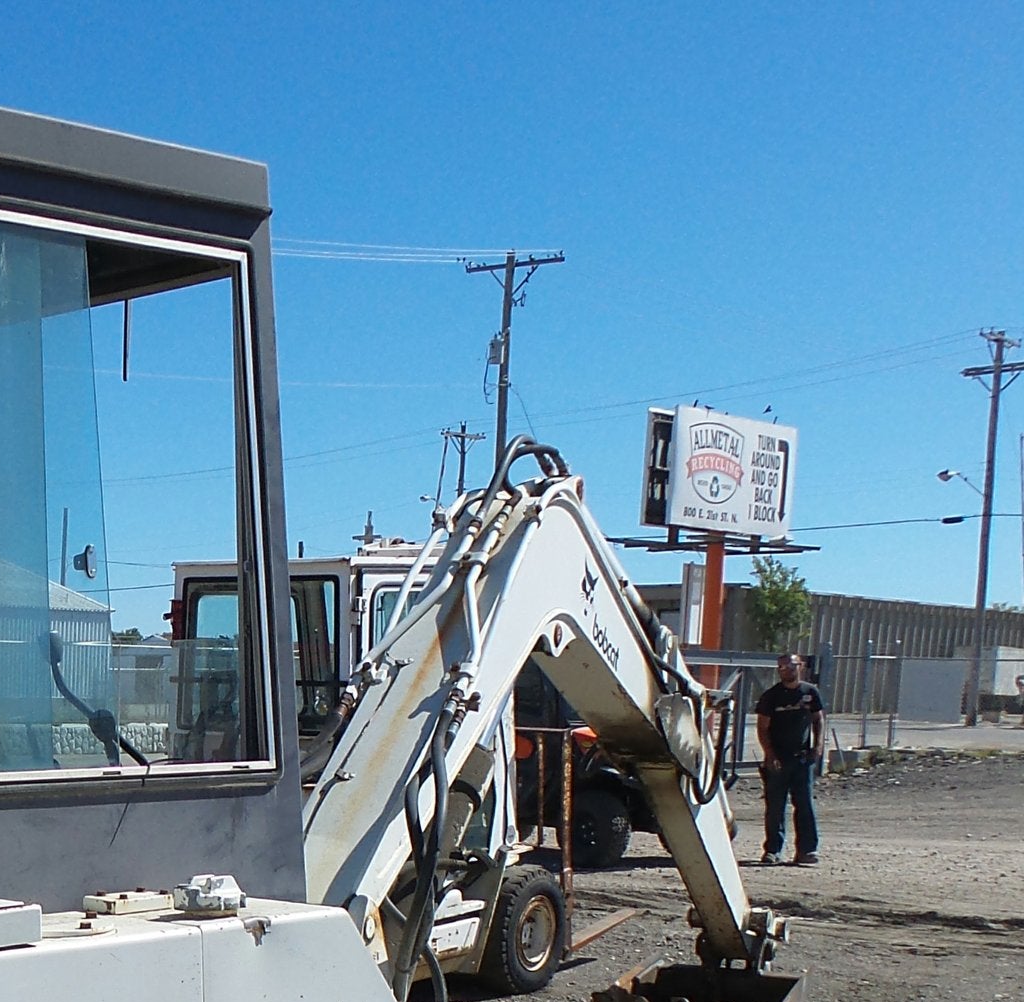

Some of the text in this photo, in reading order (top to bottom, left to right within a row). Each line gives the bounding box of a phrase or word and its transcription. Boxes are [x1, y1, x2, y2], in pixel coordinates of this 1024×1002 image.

[694, 429, 740, 458] ALLMETAL
[758, 434, 776, 451] TURN
[691, 456, 741, 478] RECYCLING
[751, 452, 781, 470] AROUND
[751, 471, 779, 487] AND GO
[754, 487, 773, 504] BACK
[683, 506, 696, 517] 800
[698, 508, 704, 519] E.
[748, 504, 777, 523] 1 BLOCK
[592, 613, 619, 671] bobcat
